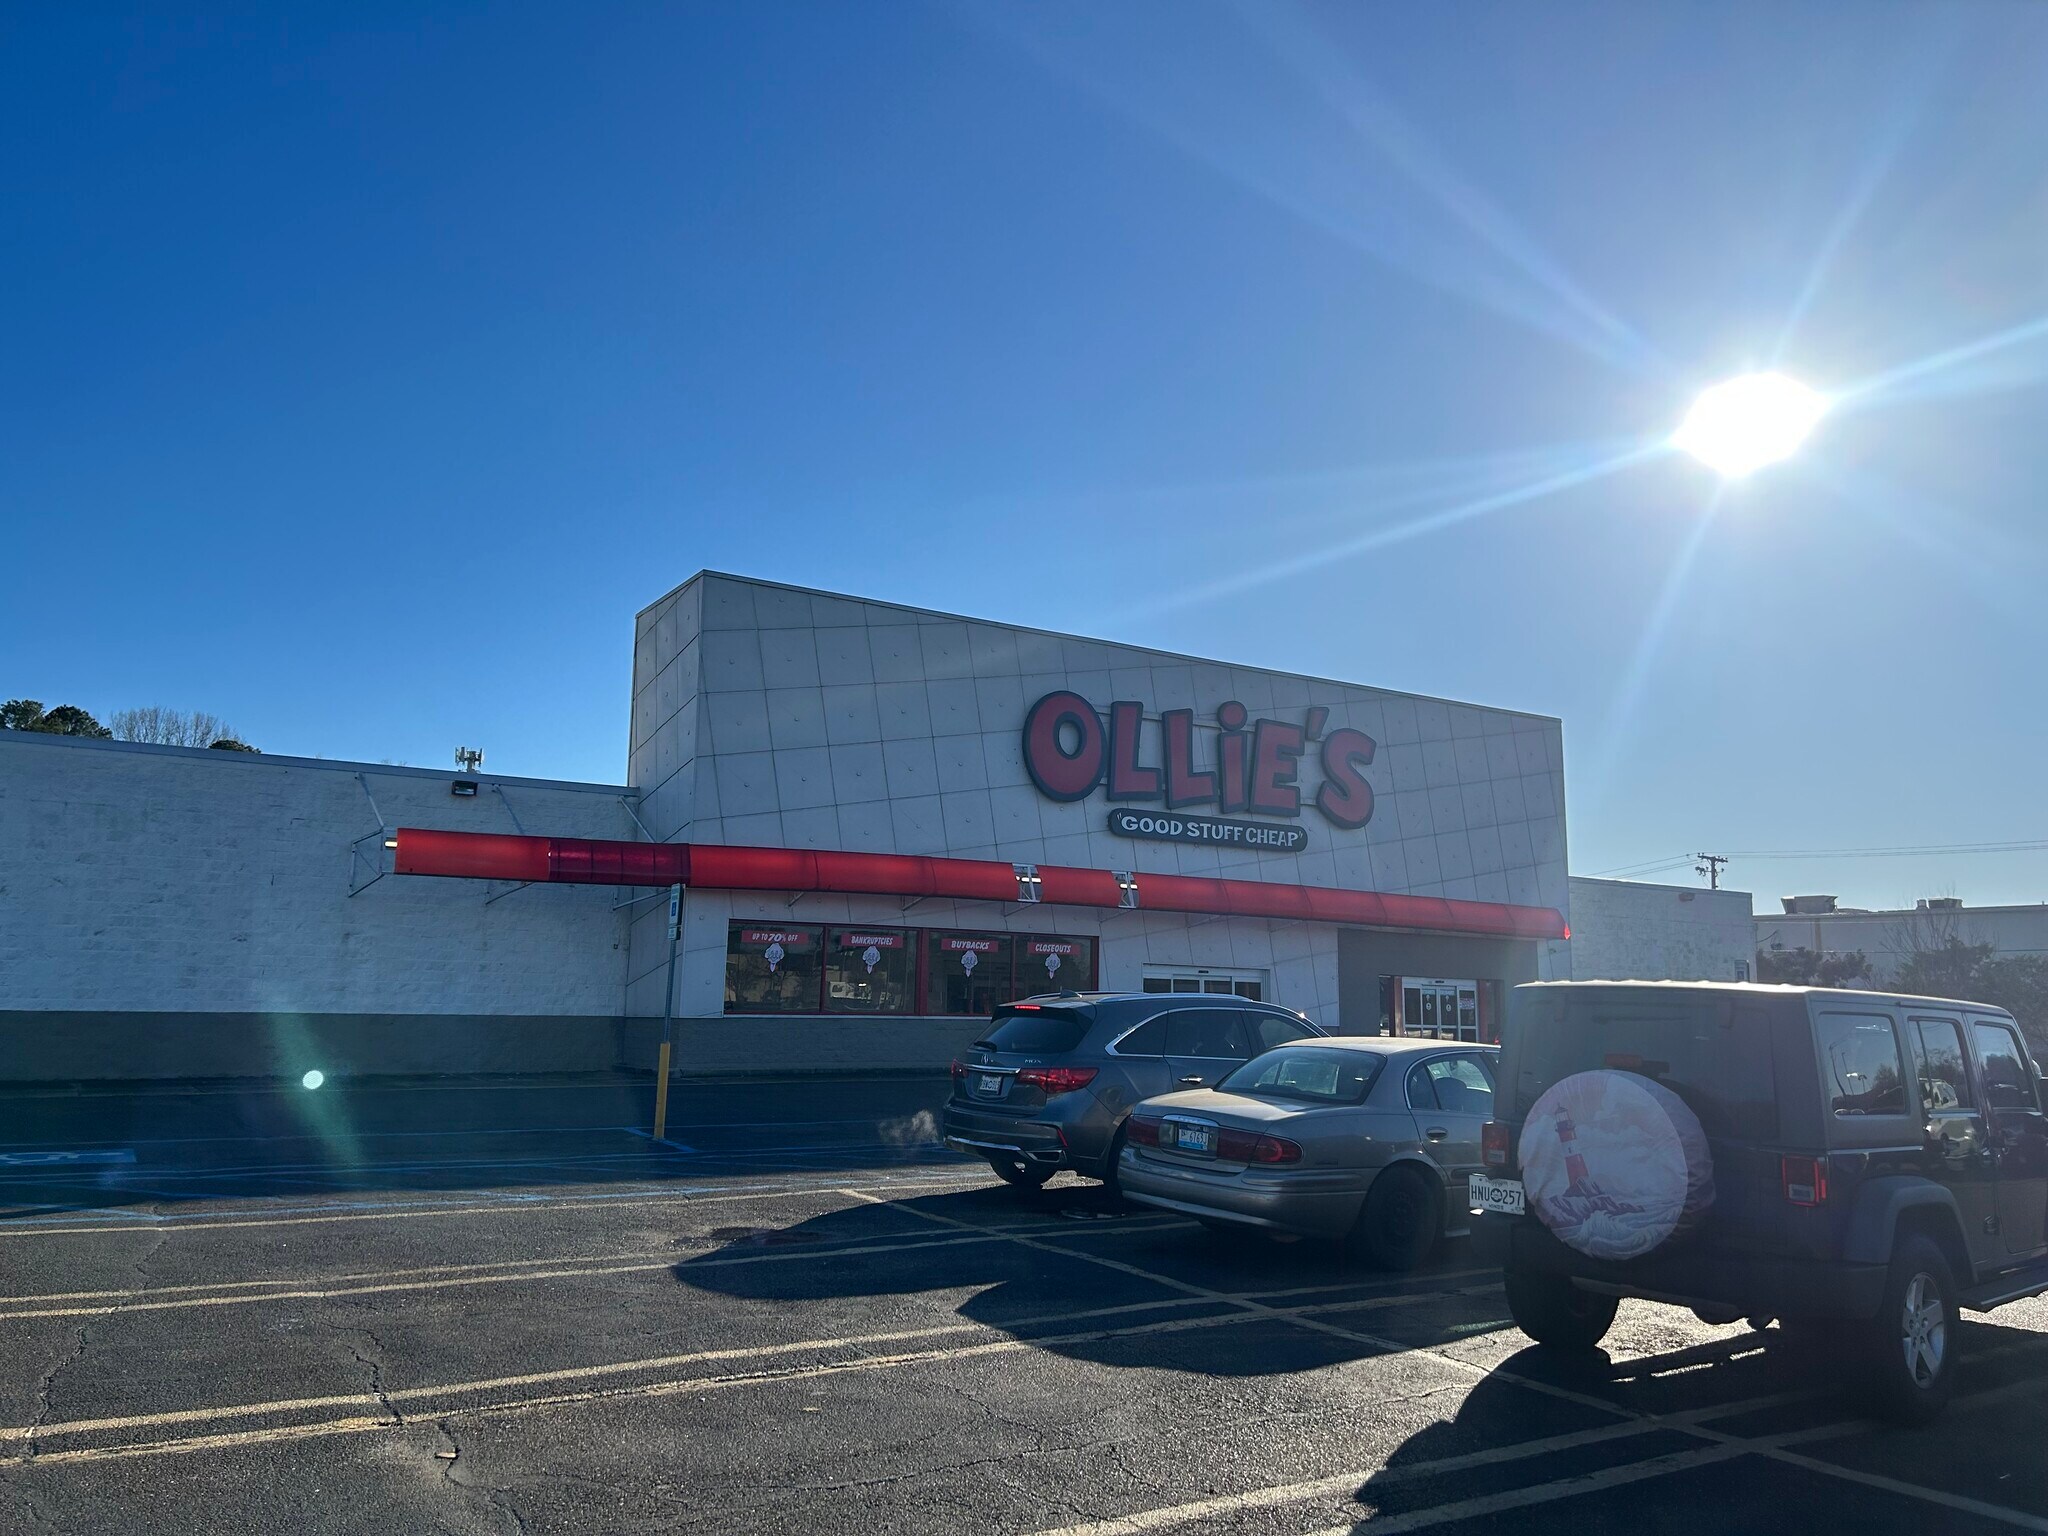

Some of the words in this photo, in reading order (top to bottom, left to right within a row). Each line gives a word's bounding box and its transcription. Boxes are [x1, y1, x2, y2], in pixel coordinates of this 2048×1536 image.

[1186, 822, 1243, 841] STUFF
[752, 932, 761, 941] UP
[761, 933, 769, 941] TO
[768, 933, 787, 942] 70%
[787, 934, 799, 942] OFF
[850, 935, 894, 946] BANKRUPTCIES
[951, 940, 990, 950] BUYBACKS
[1035, 943, 1072, 953] CLOSEOUTS
